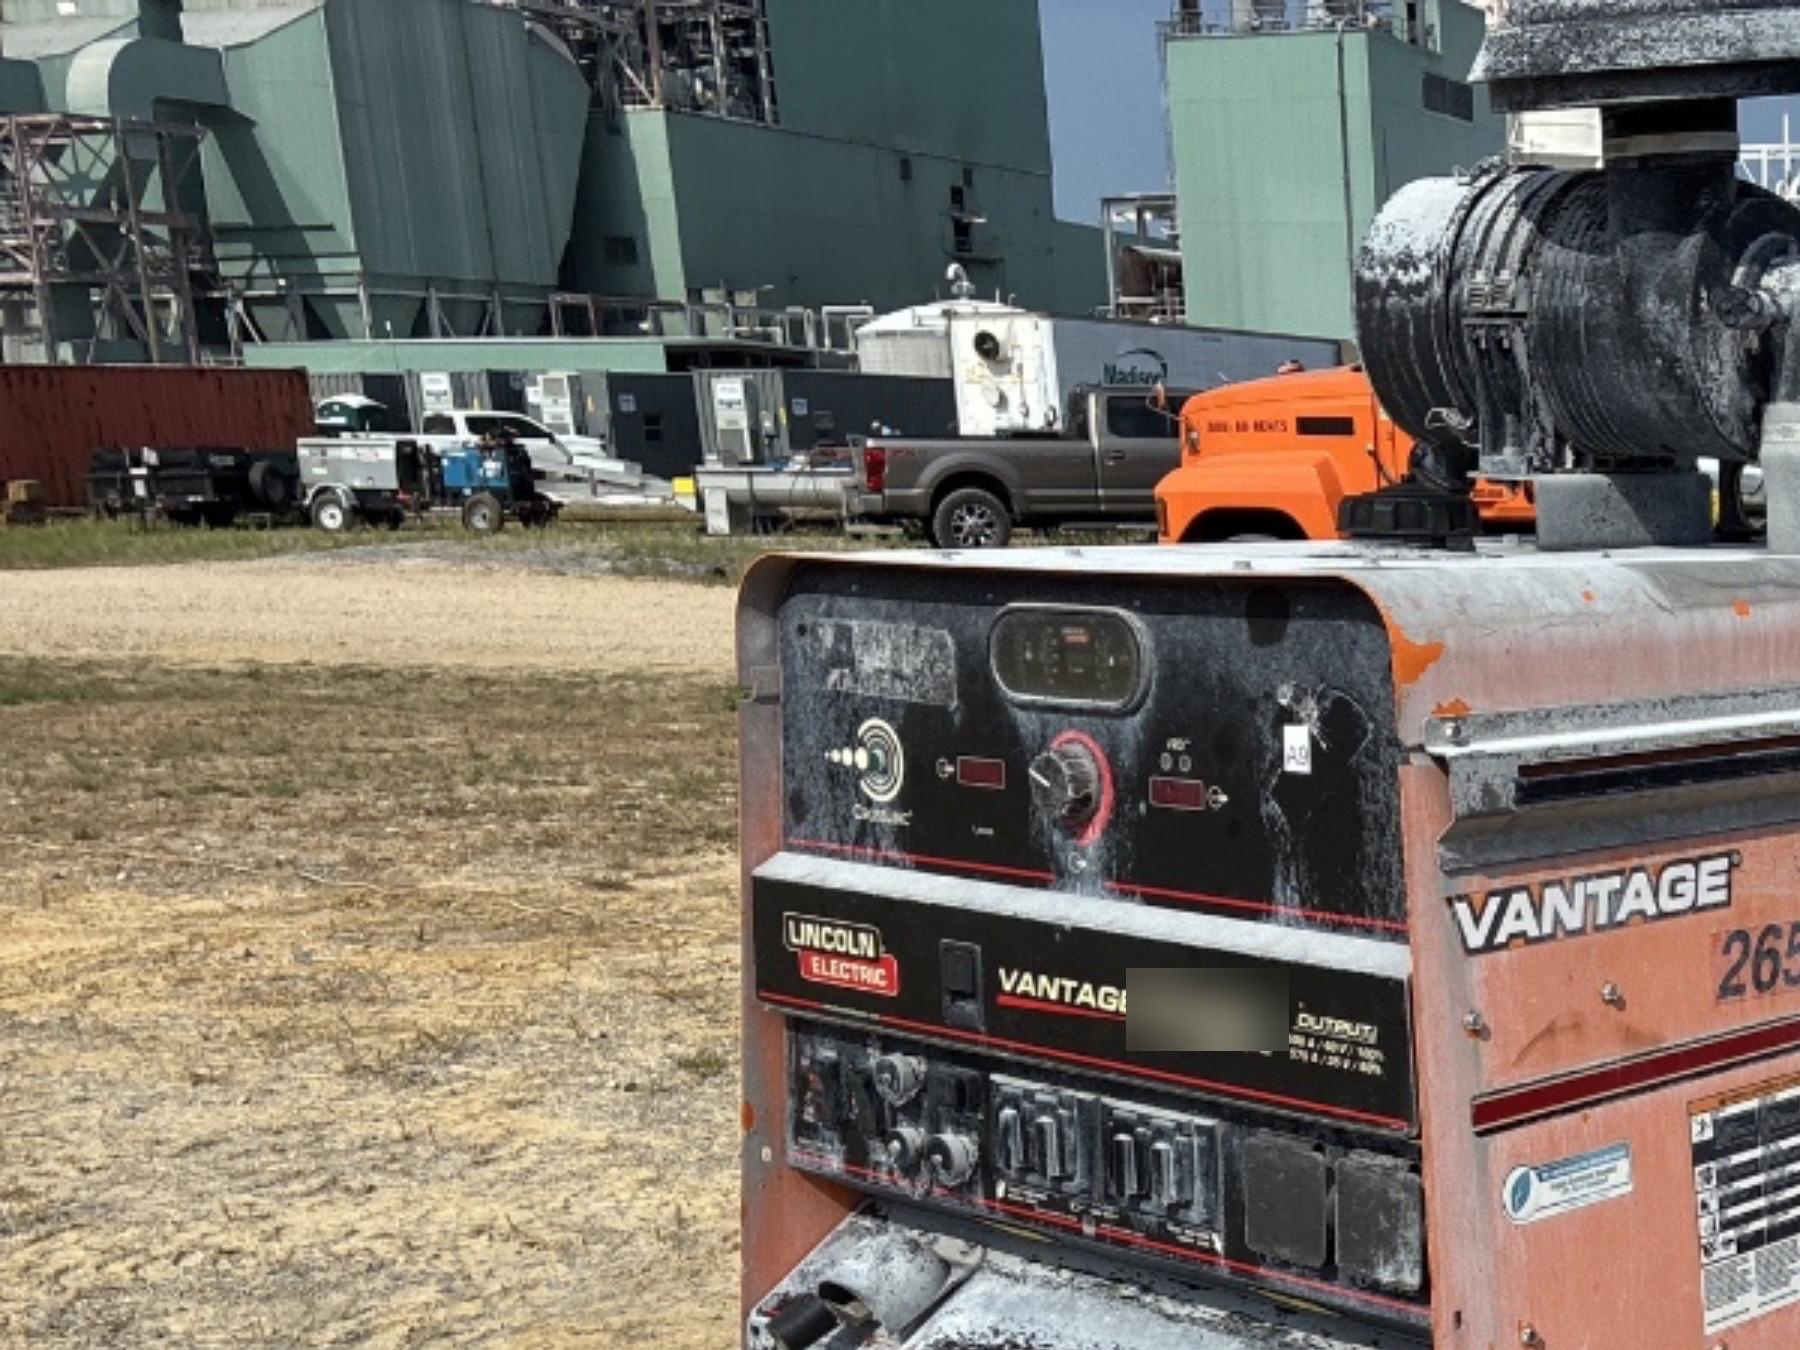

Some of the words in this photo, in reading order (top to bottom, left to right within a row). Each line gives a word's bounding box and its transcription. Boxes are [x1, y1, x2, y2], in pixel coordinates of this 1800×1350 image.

[1452, 854, 1733, 952] VANTAGE
[788, 919, 876, 958] LINCOLN
[811, 956, 888, 988] ELECTRIC
